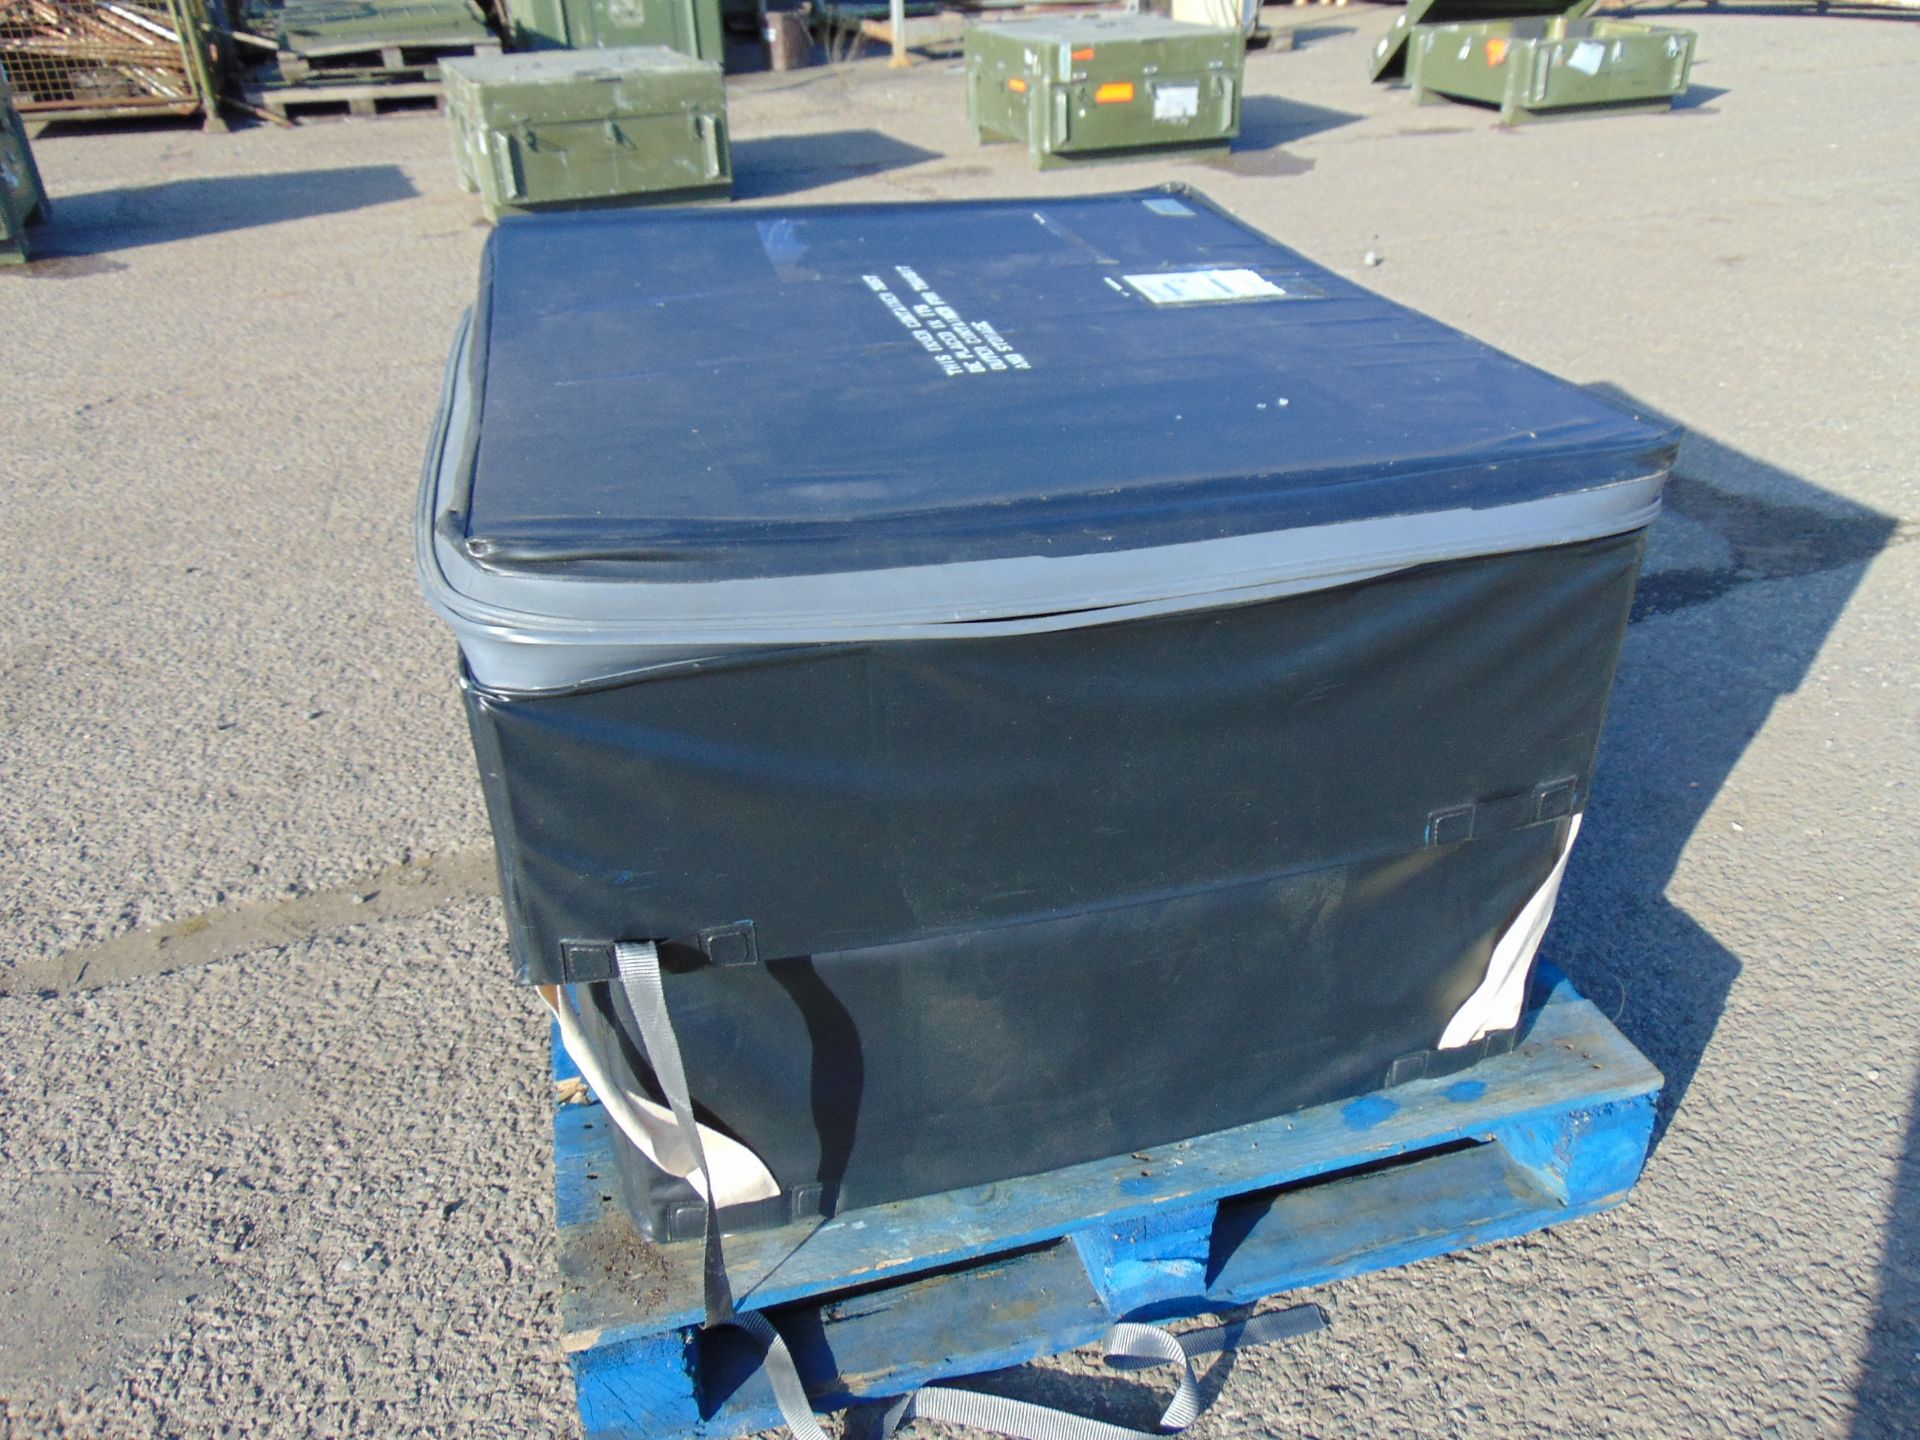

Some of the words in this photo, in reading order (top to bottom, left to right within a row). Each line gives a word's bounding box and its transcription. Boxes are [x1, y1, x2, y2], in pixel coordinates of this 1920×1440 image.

[879, 292, 921, 328] CONTAINER
[927, 320, 946, 329] IN
[935, 306, 982, 344] CONTAINER
[971, 321, 1013, 352] STORAGE
[937, 332, 974, 359] PLACED
[935, 355, 963, 376] THIS
[963, 361, 986, 373] BE
[1004, 354, 1031, 368] AND
